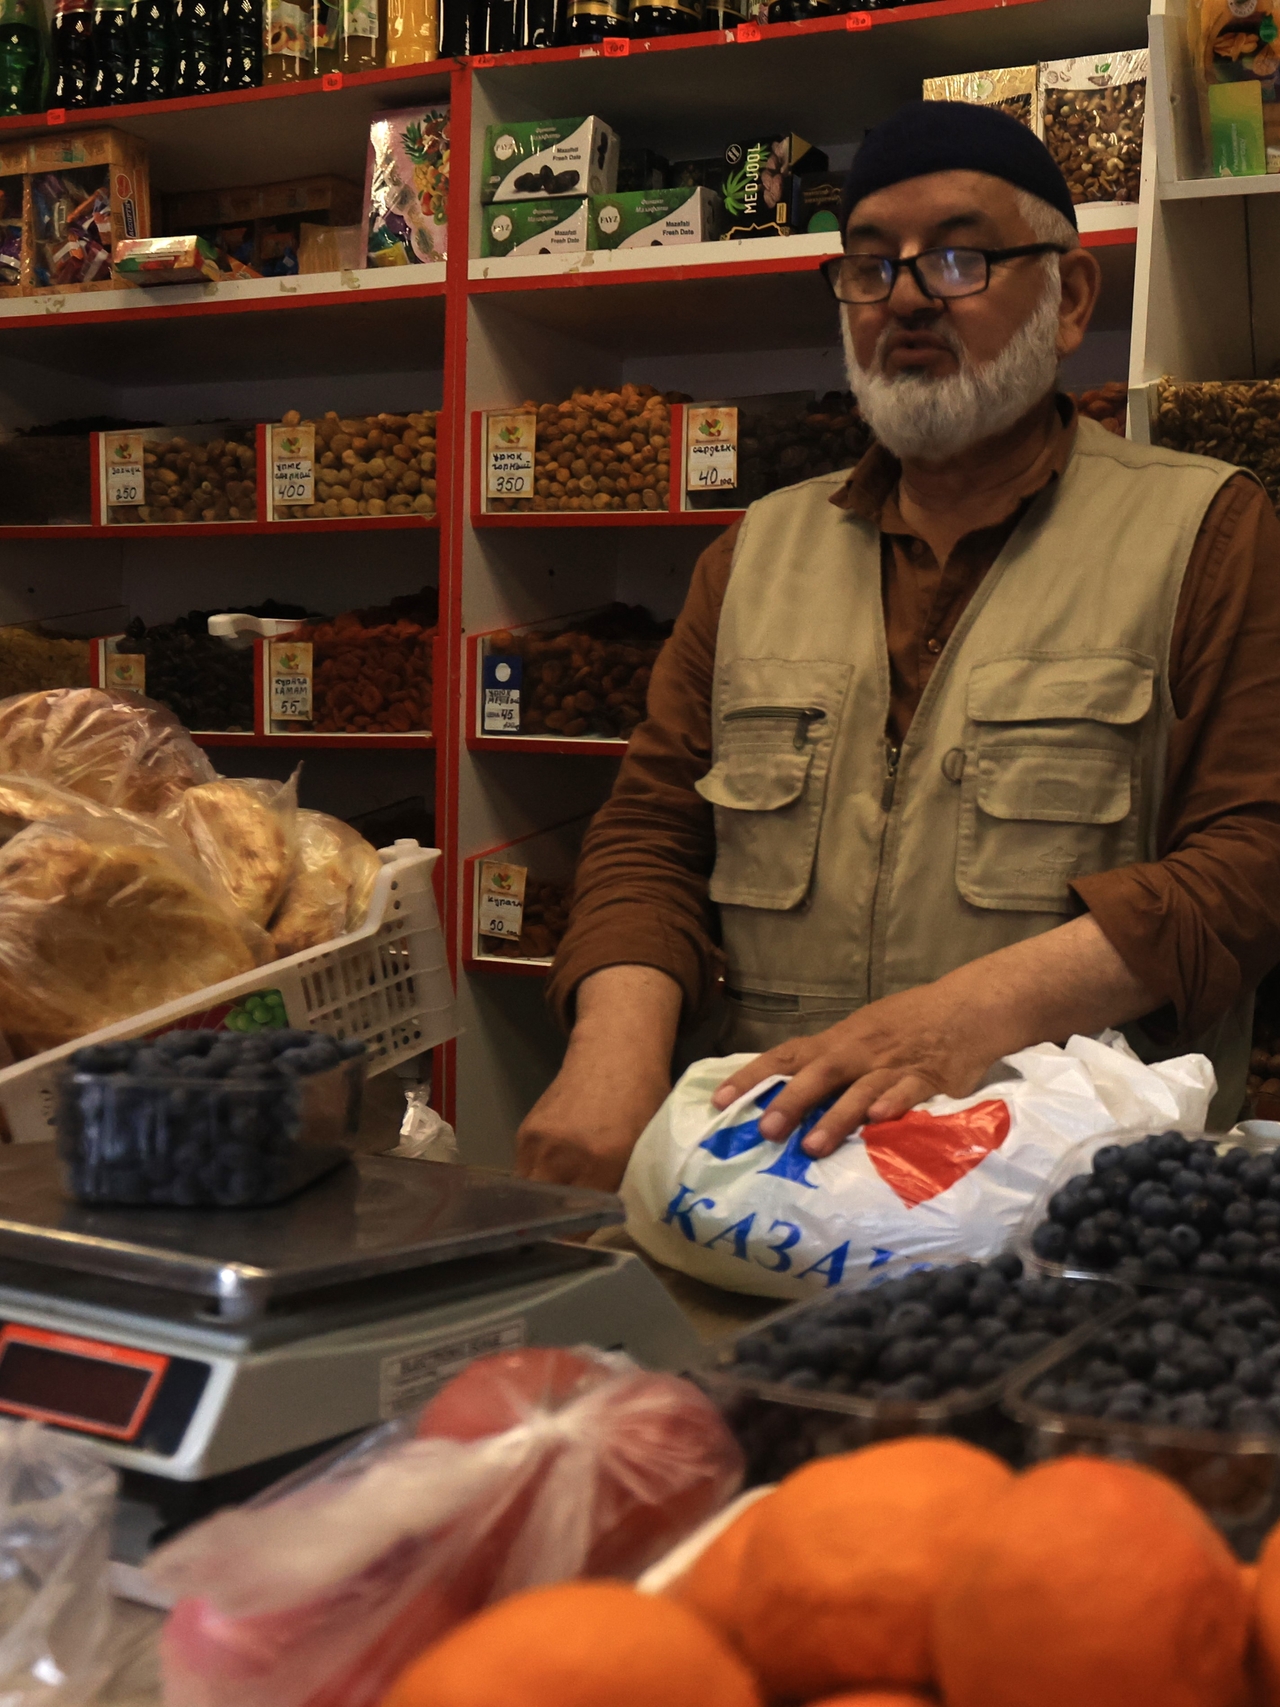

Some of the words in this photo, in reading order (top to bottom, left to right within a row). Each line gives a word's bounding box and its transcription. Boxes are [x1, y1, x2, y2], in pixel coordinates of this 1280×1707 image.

[744, 142, 761, 215] MEDJOOL
[496, 476, 524, 492] 350
[699, 467, 718, 486] 40
[116, 487, 137, 501] 250
[278, 484, 305, 499] 400
[281, 700, 300, 714] 55
[501, 709, 514, 720] 45
[489, 919, 504, 931] 50
[660, 1183, 933, 1290] КАЗА
